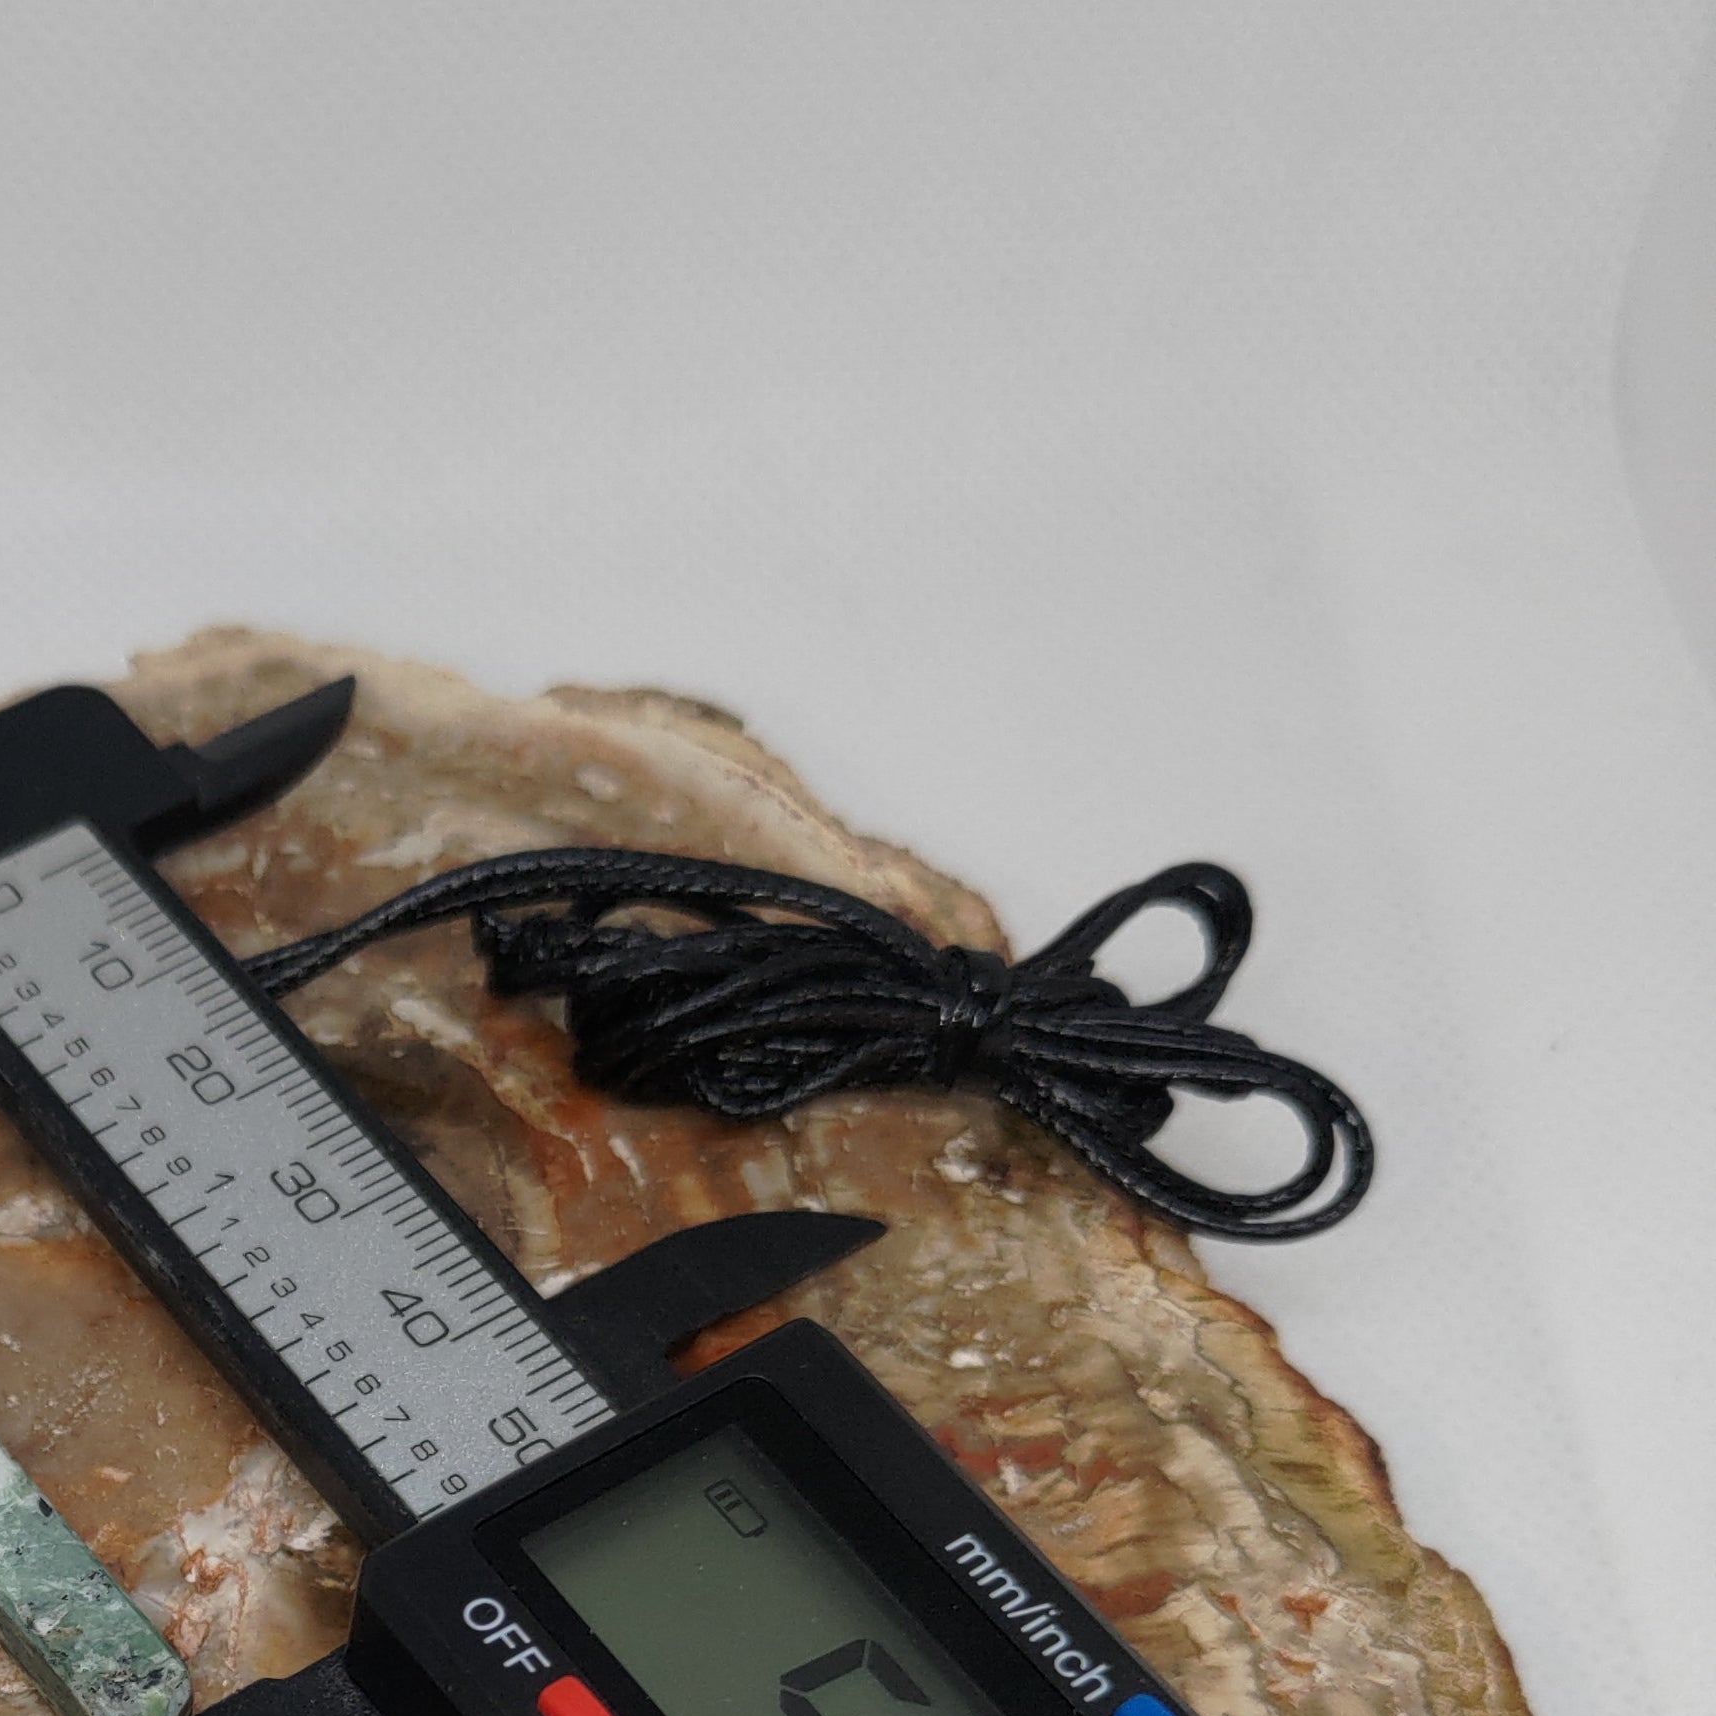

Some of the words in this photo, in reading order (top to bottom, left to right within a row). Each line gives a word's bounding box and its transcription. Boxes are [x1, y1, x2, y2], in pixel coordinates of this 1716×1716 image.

[15, 980, 42, 1002] 3
[41, 1012, 66, 1029] 4
[64, 1036, 91, 1058] 5
[89, 1066, 116, 1088] 6
[115, 1094, 143, 1115] 7
[139, 1124, 167, 1147] 8
[165, 1155, 193, 1177] 9
[203, 1172, 237, 1195] 1
[220, 1217, 241, 1232] 1
[241, 1246, 272, 1269] 2
[269, 1276, 299, 1299] 3
[299, 1310, 326, 1330] 4
[324, 1339, 355, 1363] 5
[353, 1373, 382, 1397] 6
[382, 1404, 413, 1425] 7
[409, 1438, 441, 1463] 8
[439, 1472, 469, 1496] 9
[78, 940, 135, 992] 10
[164, 1044, 237, 1107] 20
[269, 1160, 342, 1225] 30
[378, 1288, 451, 1349] 40
[462, 1596, 552, 1676] OFF
[944, 1533, 1114, 1703] mm/inch
